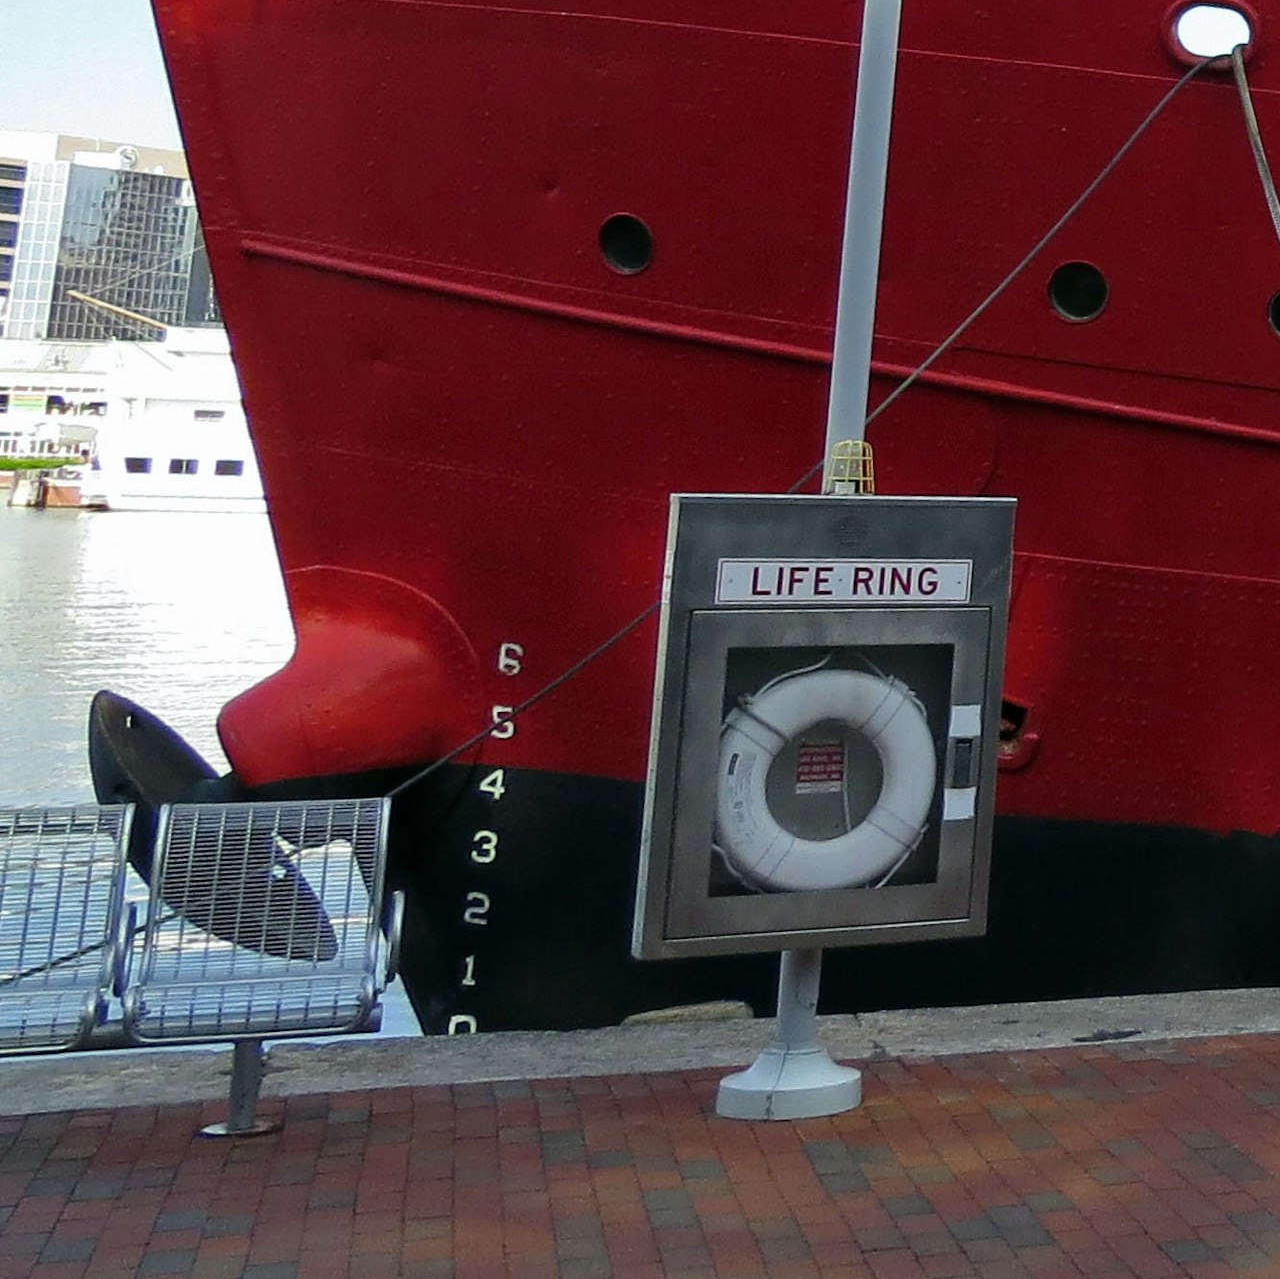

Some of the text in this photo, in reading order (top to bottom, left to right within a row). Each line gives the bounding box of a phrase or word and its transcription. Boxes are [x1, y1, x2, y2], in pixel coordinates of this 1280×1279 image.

[751, 567, 939, 597] LIFE RING
[499, 643, 524, 675] 6
[490, 705, 516, 739] 5
[479, 768, 506, 801] 4
[471, 829, 499, 864] 3
[464, 891, 491, 925] 2
[461, 954, 477, 986] 1
